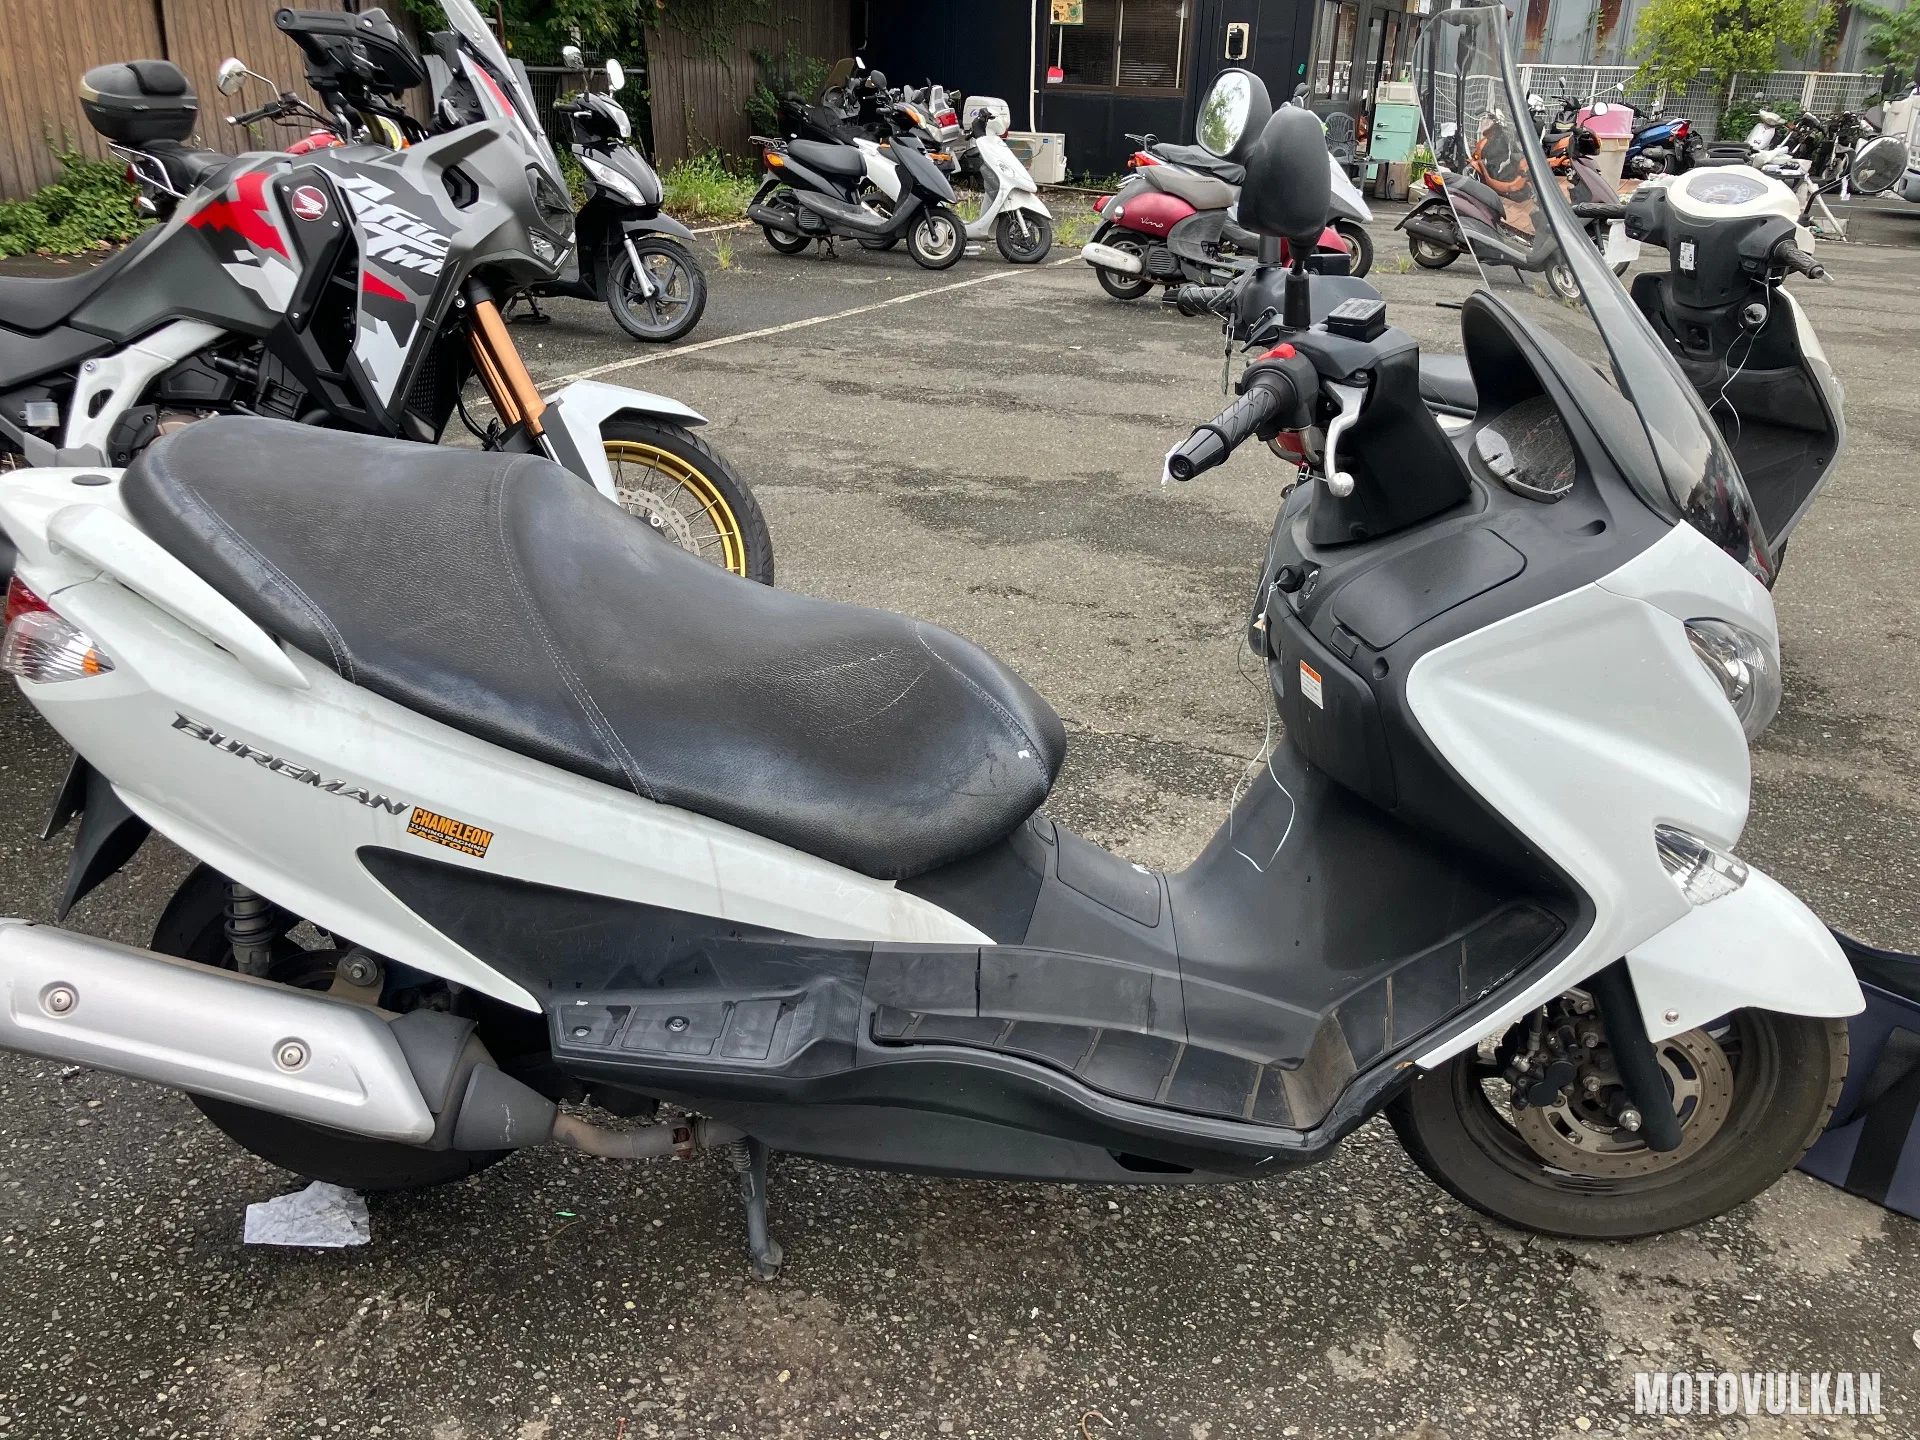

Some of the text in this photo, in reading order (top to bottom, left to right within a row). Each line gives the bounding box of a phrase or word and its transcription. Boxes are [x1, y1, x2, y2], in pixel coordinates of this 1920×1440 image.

[343, 172, 452, 252] Afric
[1141, 216, 1163, 228] Vino
[361, 222, 447, 277] Twi
[170, 711, 411, 816] BURGMAN
[407, 826, 485, 857] FACTORY
[410, 822, 487, 852] TUNING MACHINE
[411, 808, 493, 848] CHAMELEON
